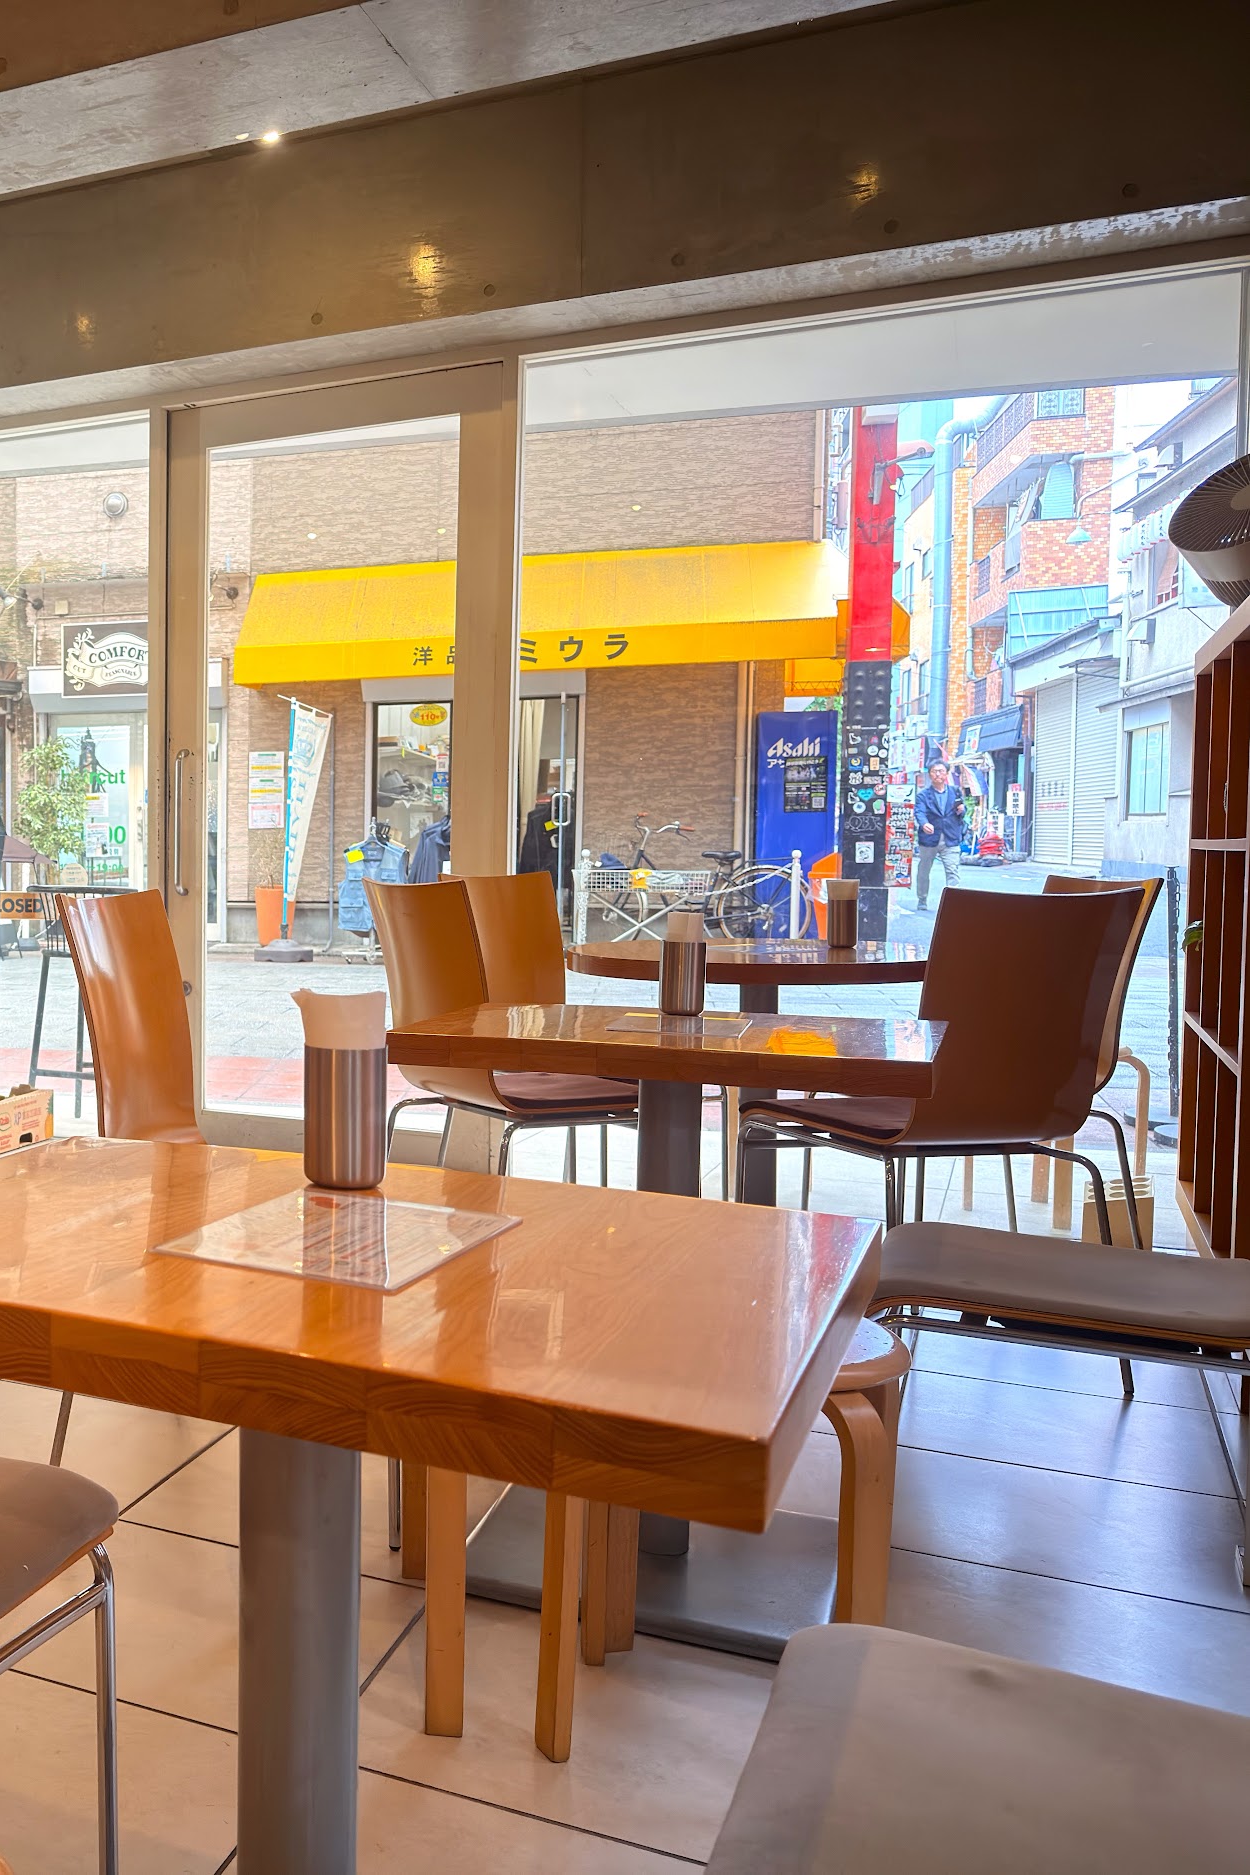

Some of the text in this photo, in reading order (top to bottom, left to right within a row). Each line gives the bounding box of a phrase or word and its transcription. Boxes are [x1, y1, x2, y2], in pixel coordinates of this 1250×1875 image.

[89, 645, 149, 664] COMFOR
[766, 737, 821, 758] Asahi
[60, 769, 126, 785] hircut
